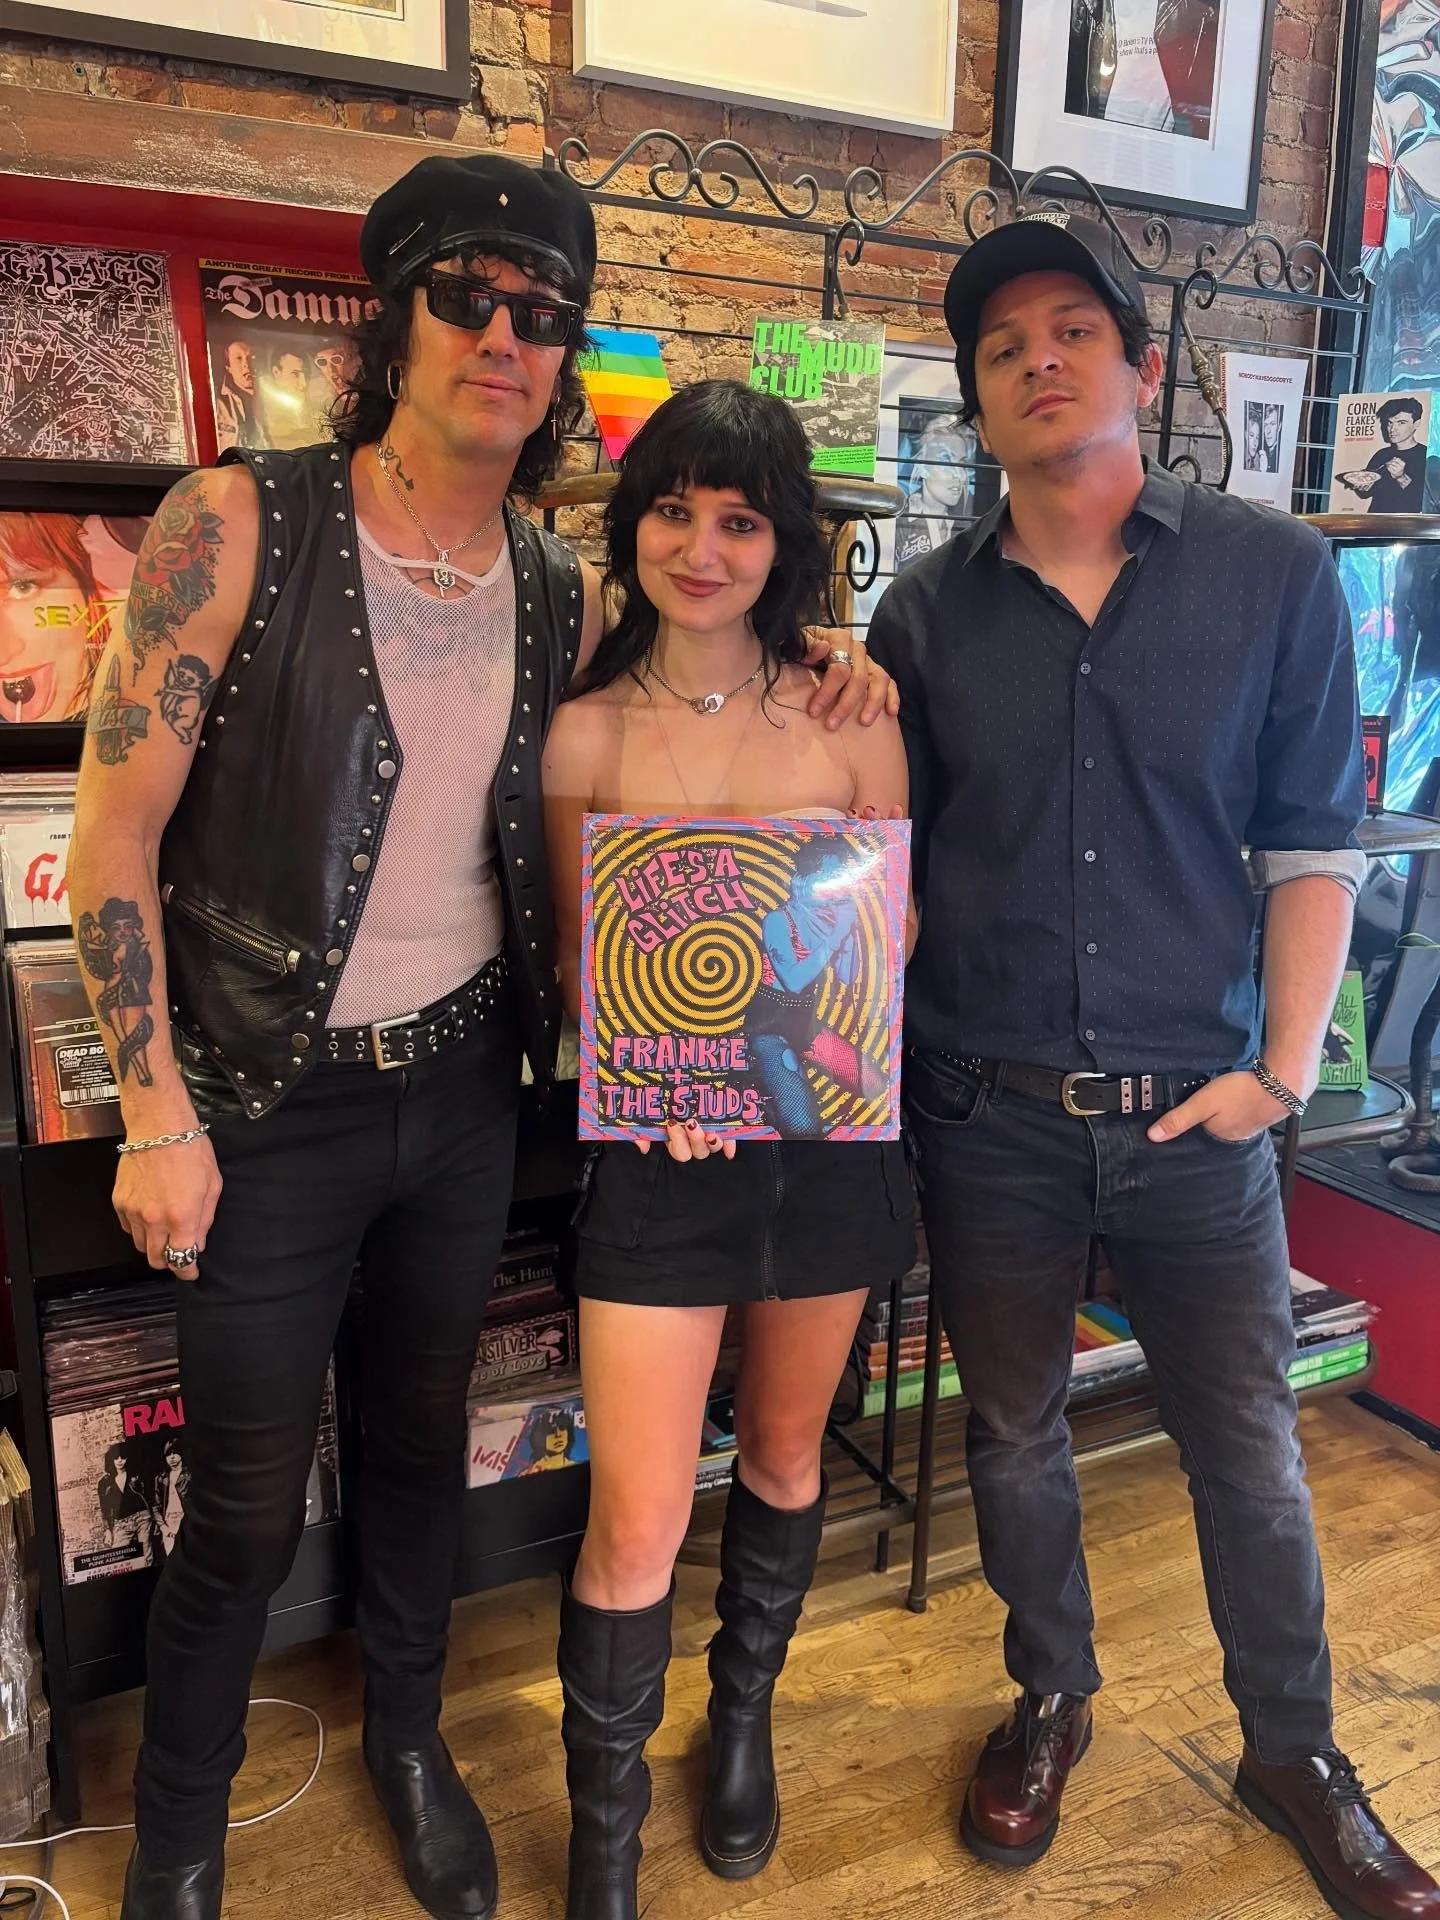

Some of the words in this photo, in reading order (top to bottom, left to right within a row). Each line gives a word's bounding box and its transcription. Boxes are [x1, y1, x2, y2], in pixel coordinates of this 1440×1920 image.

[205, 259, 250, 271] ANOTHER
[251, 264, 284, 274] GREAT
[285, 268, 323, 278] RECORD
[324, 272, 350, 281] FROM
[205, 285, 233, 302] The
[756, 323, 806, 353] THE
[801, 340, 882, 375] MUDD
[751, 365, 823, 400] CLUB
[1347, 402, 1377, 415] CORN
[1346, 415, 1376, 426] FLAKES
[1345, 426, 1375, 437] SERIES
[714, 848, 742, 878] A
[60, 1048, 88, 1059] DEAD
[89, 1045, 107, 1055] BO
[665, 1069, 692, 1084] +
[1324, 1058, 1362, 1082] SMITH
[601, 1085, 664, 1119] THE
[671, 1084, 761, 1121] STUDS
[512, 1356, 546, 1371] Love
